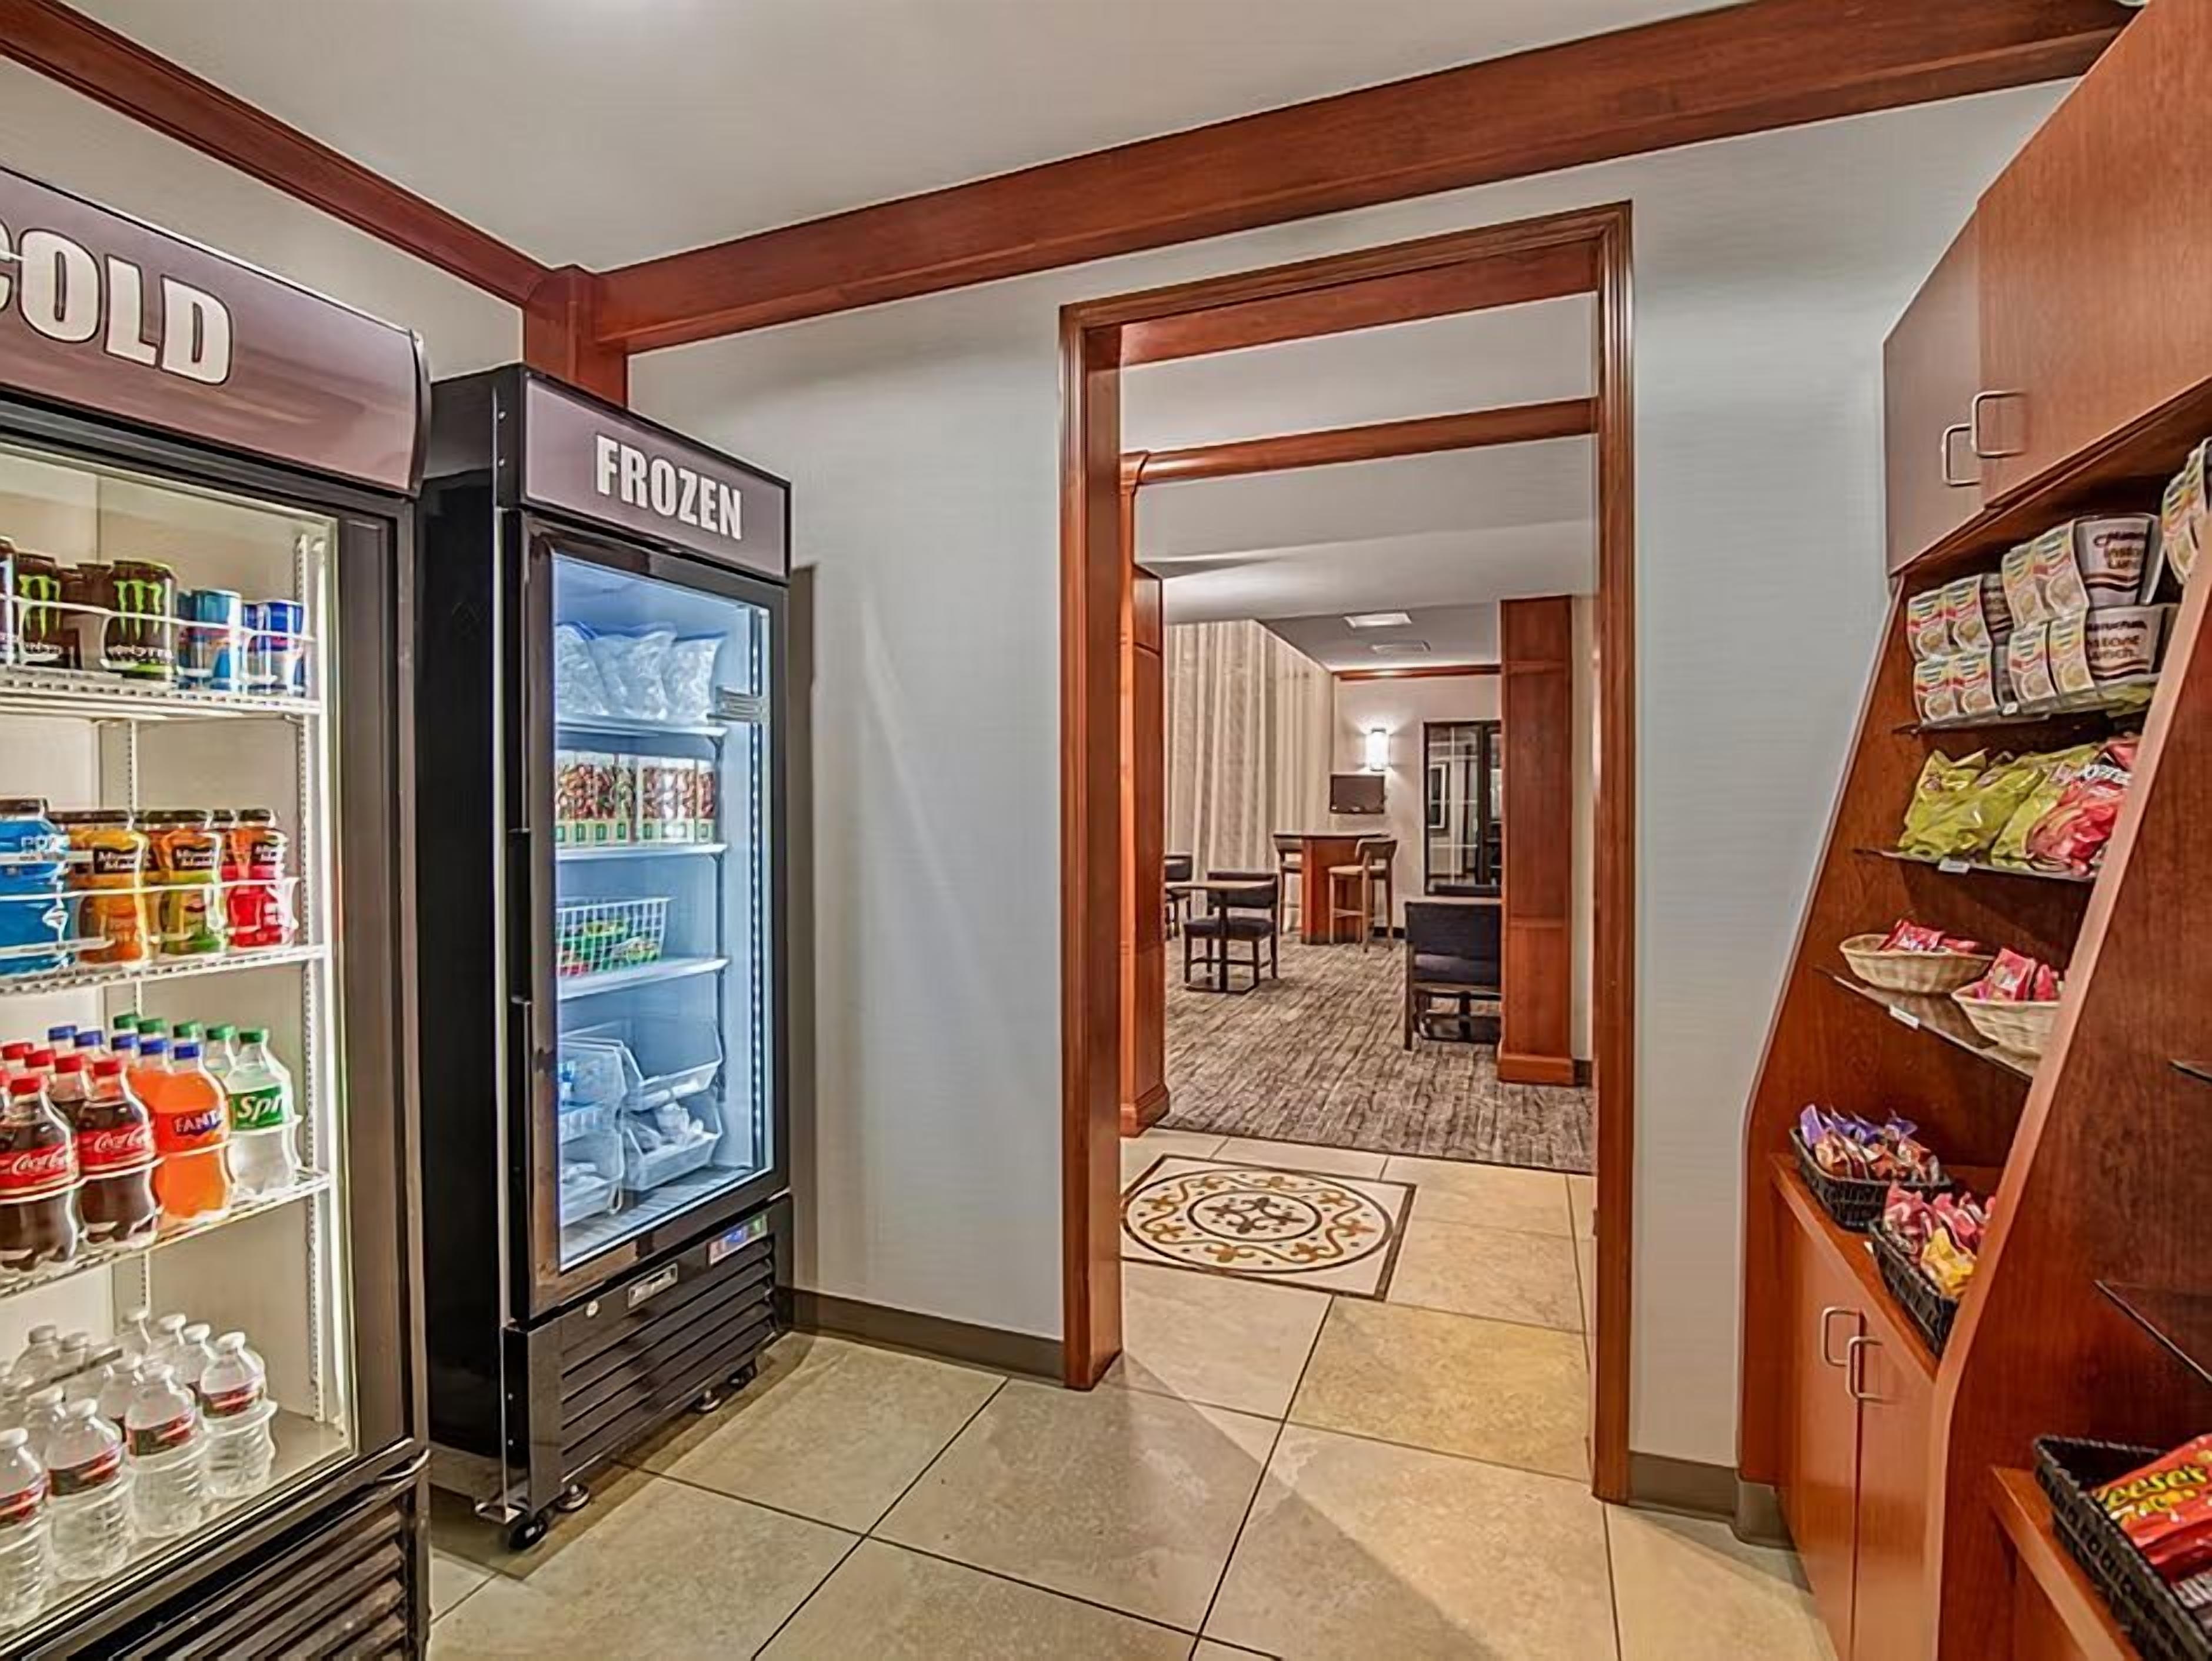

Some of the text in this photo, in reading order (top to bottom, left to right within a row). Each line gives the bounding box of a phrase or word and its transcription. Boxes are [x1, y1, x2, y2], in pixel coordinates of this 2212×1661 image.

[0, 218, 232, 384] OLD
[596, 434, 742, 540] FROZEN
[174, 1110, 220, 1133] FANT
